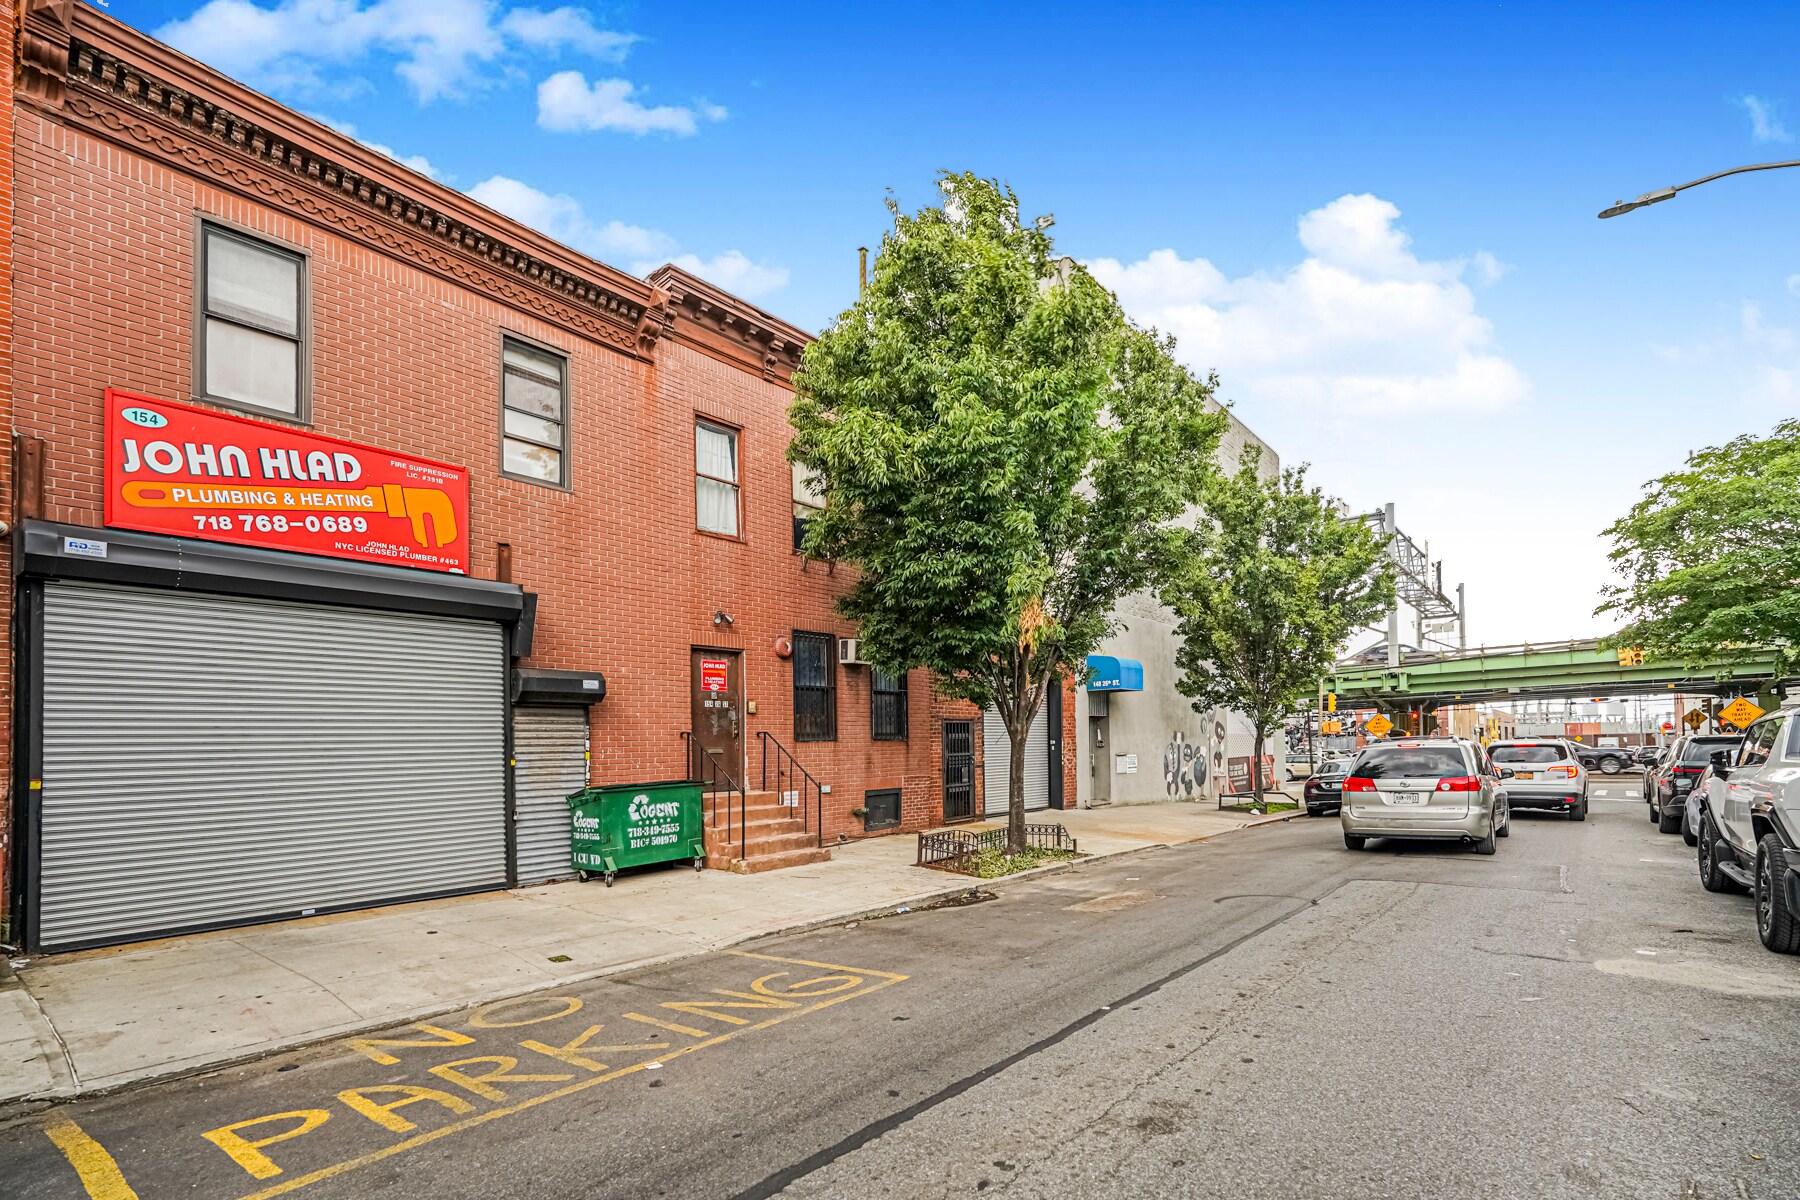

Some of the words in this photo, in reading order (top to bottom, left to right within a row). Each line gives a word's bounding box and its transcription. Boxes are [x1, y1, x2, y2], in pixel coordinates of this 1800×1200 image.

[131, 410, 159, 425] 154
[122, 439, 251, 478] JOHN
[257, 447, 362, 482] HLAD
[390, 461, 407, 470] FIRE
[409, 464, 459, 480] SUPPRESSION
[422, 475, 443, 484] #391B
[172, 488, 277, 505] PLUMBING
[283, 493, 296, 506] &
[301, 493, 374, 507] HEATING
[193, 515, 233, 530] 718
[238, 514, 368, 533] 768-0689
[335, 542, 354, 551] NYC
[355, 545, 398, 557] LICENSED
[399, 551, 438, 563] PLUMBER
[439, 557, 459, 565] #463
[366, 541, 387, 550] JOHN
[388, 544, 410, 552] HLAD
[627, 823, 680, 838] 718-349-7555
[630, 838, 649, 849] BIC#
[651, 834, 678, 846] 501970
[578, 852, 588, 864] CU
[590, 853, 601, 865] YD
[346, 996, 584, 1065] NO
[201, 972, 863, 1179] PARKING
